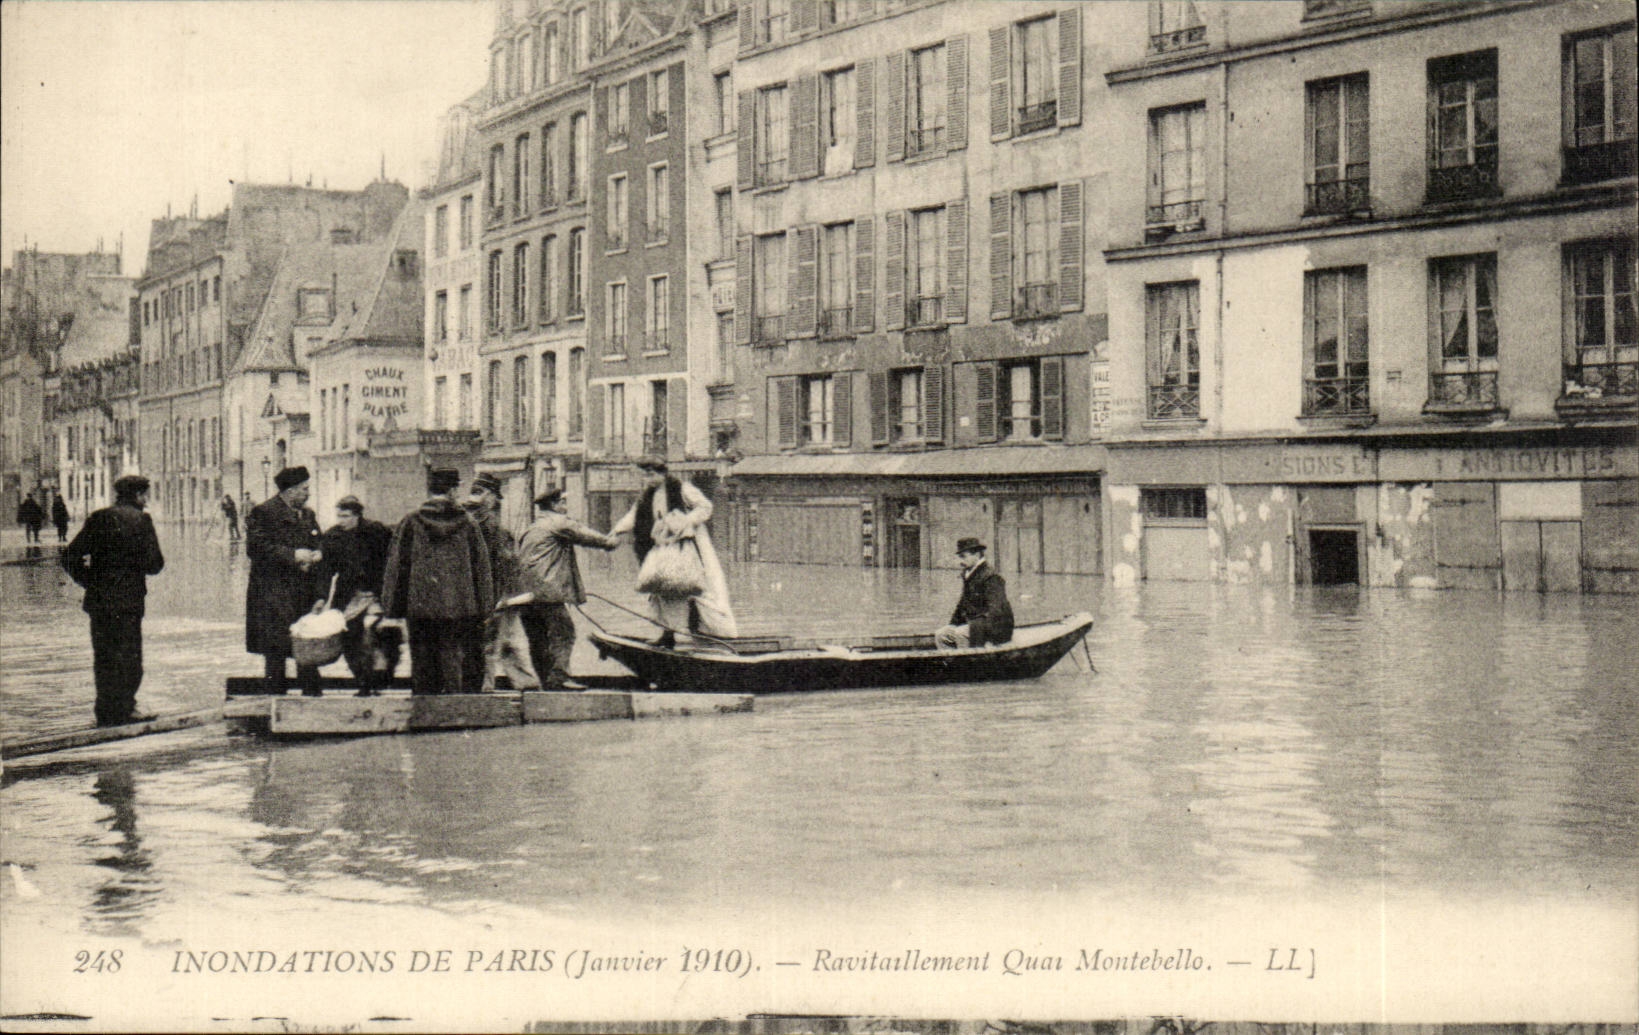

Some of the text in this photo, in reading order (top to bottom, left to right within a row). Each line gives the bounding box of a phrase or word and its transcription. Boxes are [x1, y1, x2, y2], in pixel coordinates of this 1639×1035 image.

[364, 366, 405, 381] CHAUX
[361, 385, 408, 398] CIMENT
[362, 401, 409, 418] PLATRE
